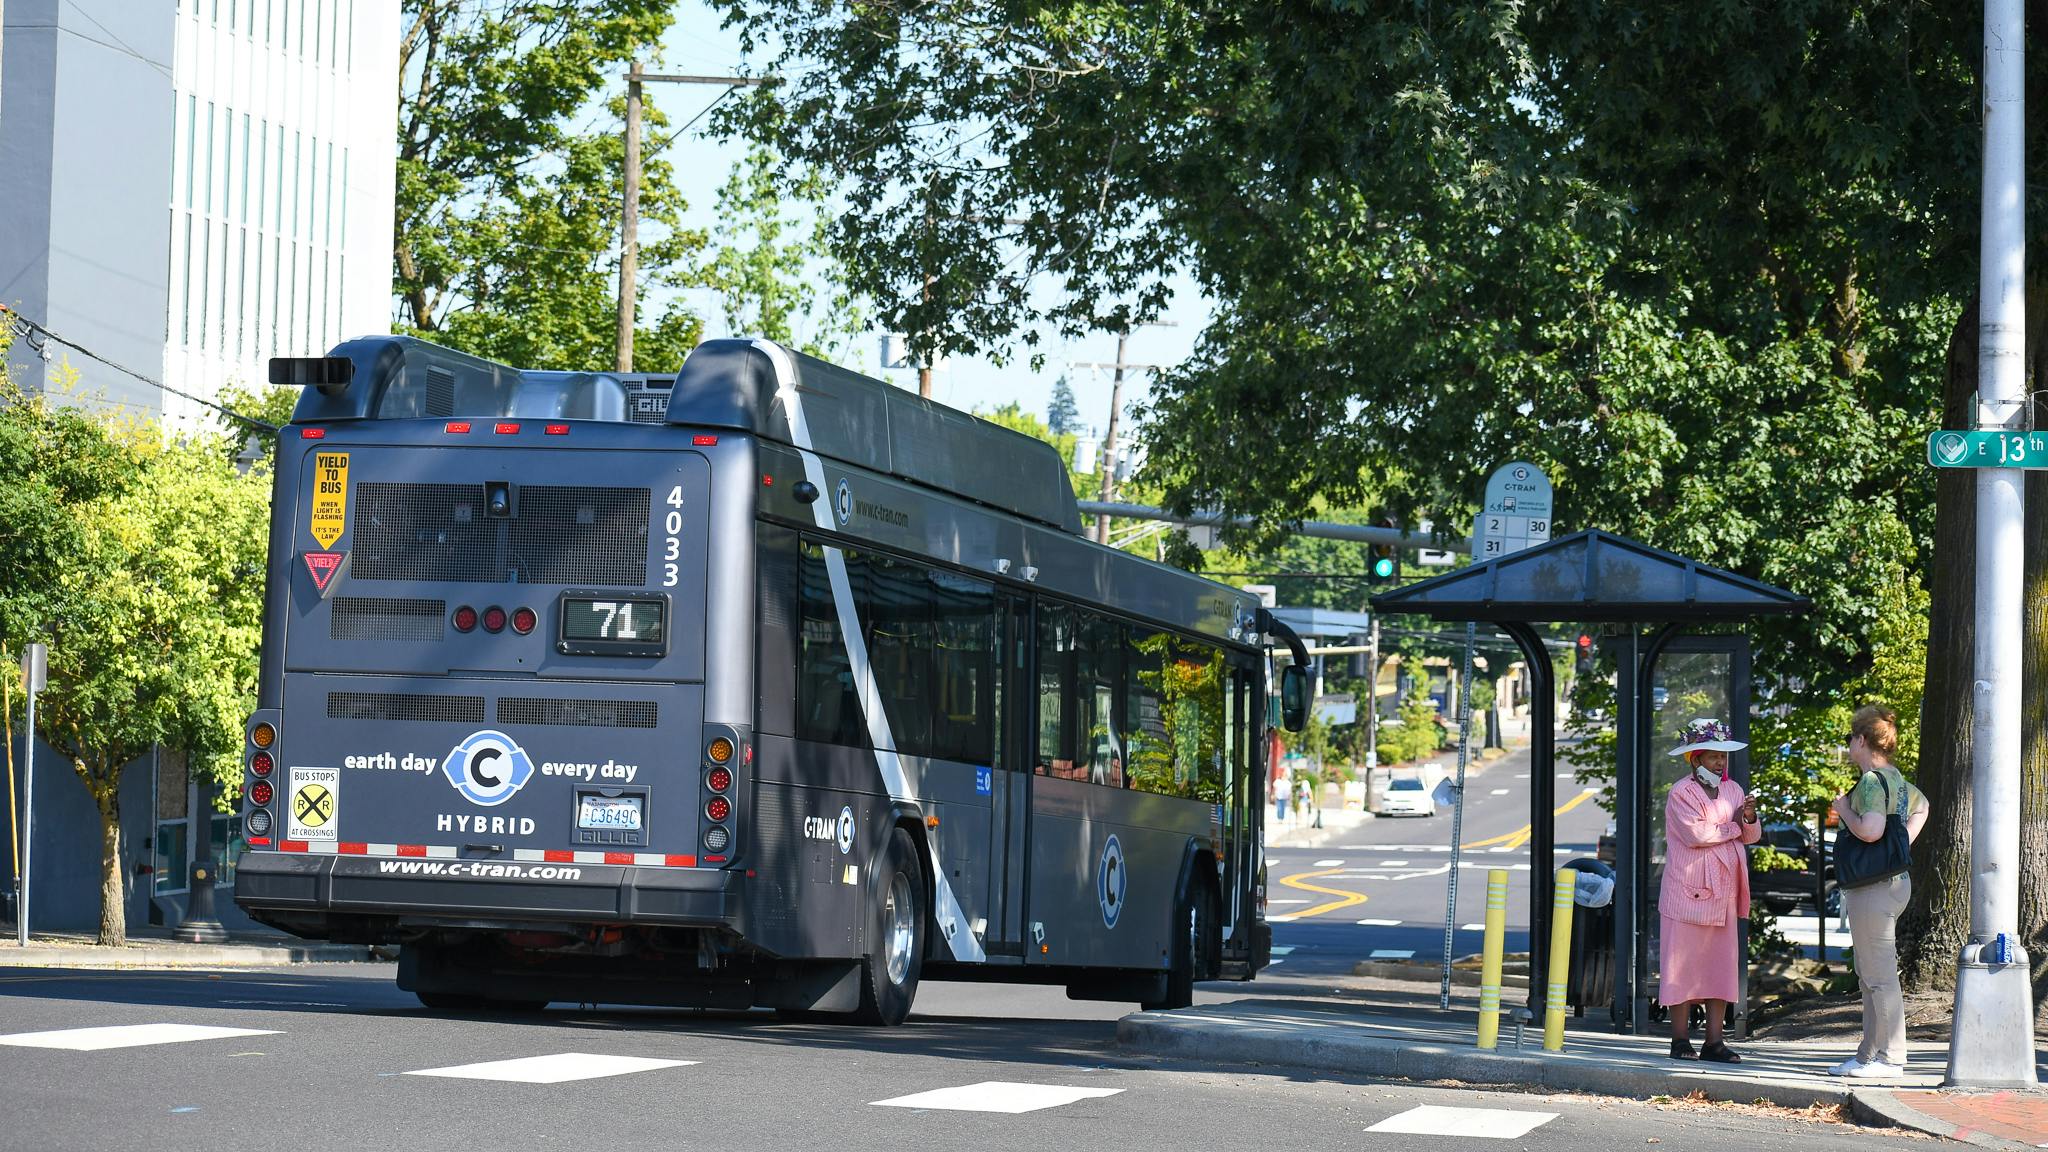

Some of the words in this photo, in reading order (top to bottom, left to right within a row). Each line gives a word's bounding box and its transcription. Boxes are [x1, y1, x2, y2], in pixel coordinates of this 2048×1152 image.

[1979, 442, 1986, 455] E
[318, 456, 347, 468] YIELD
[325, 469, 338, 481] TO
[320, 482, 342, 494] BUS
[1504, 483, 1536, 492] C-TRAN
[855, 499, 909, 529] www.c-tran.com
[1491, 519, 1499, 530] 2
[1530, 521, 1546, 532] 30
[1485, 541, 1500, 552] 31
[313, 557, 333, 568] YIELD
[592, 602, 637, 639] 71
[344, 752, 397, 770] earth
[401, 753, 438, 775] day
[294, 771, 310, 781] BUS
[311, 772, 335, 782] STOPS
[541, 761, 597, 782] every
[600, 760, 638, 783] day
[590, 808, 637, 825] C3649C
[437, 813, 536, 836] HYBRID
[804, 815, 836, 841] C-TRAN
[291, 828, 299, 836] AT
[299, 829, 334, 837] CROSSINGS
[379, 860, 581, 881] www.c-tran.com
